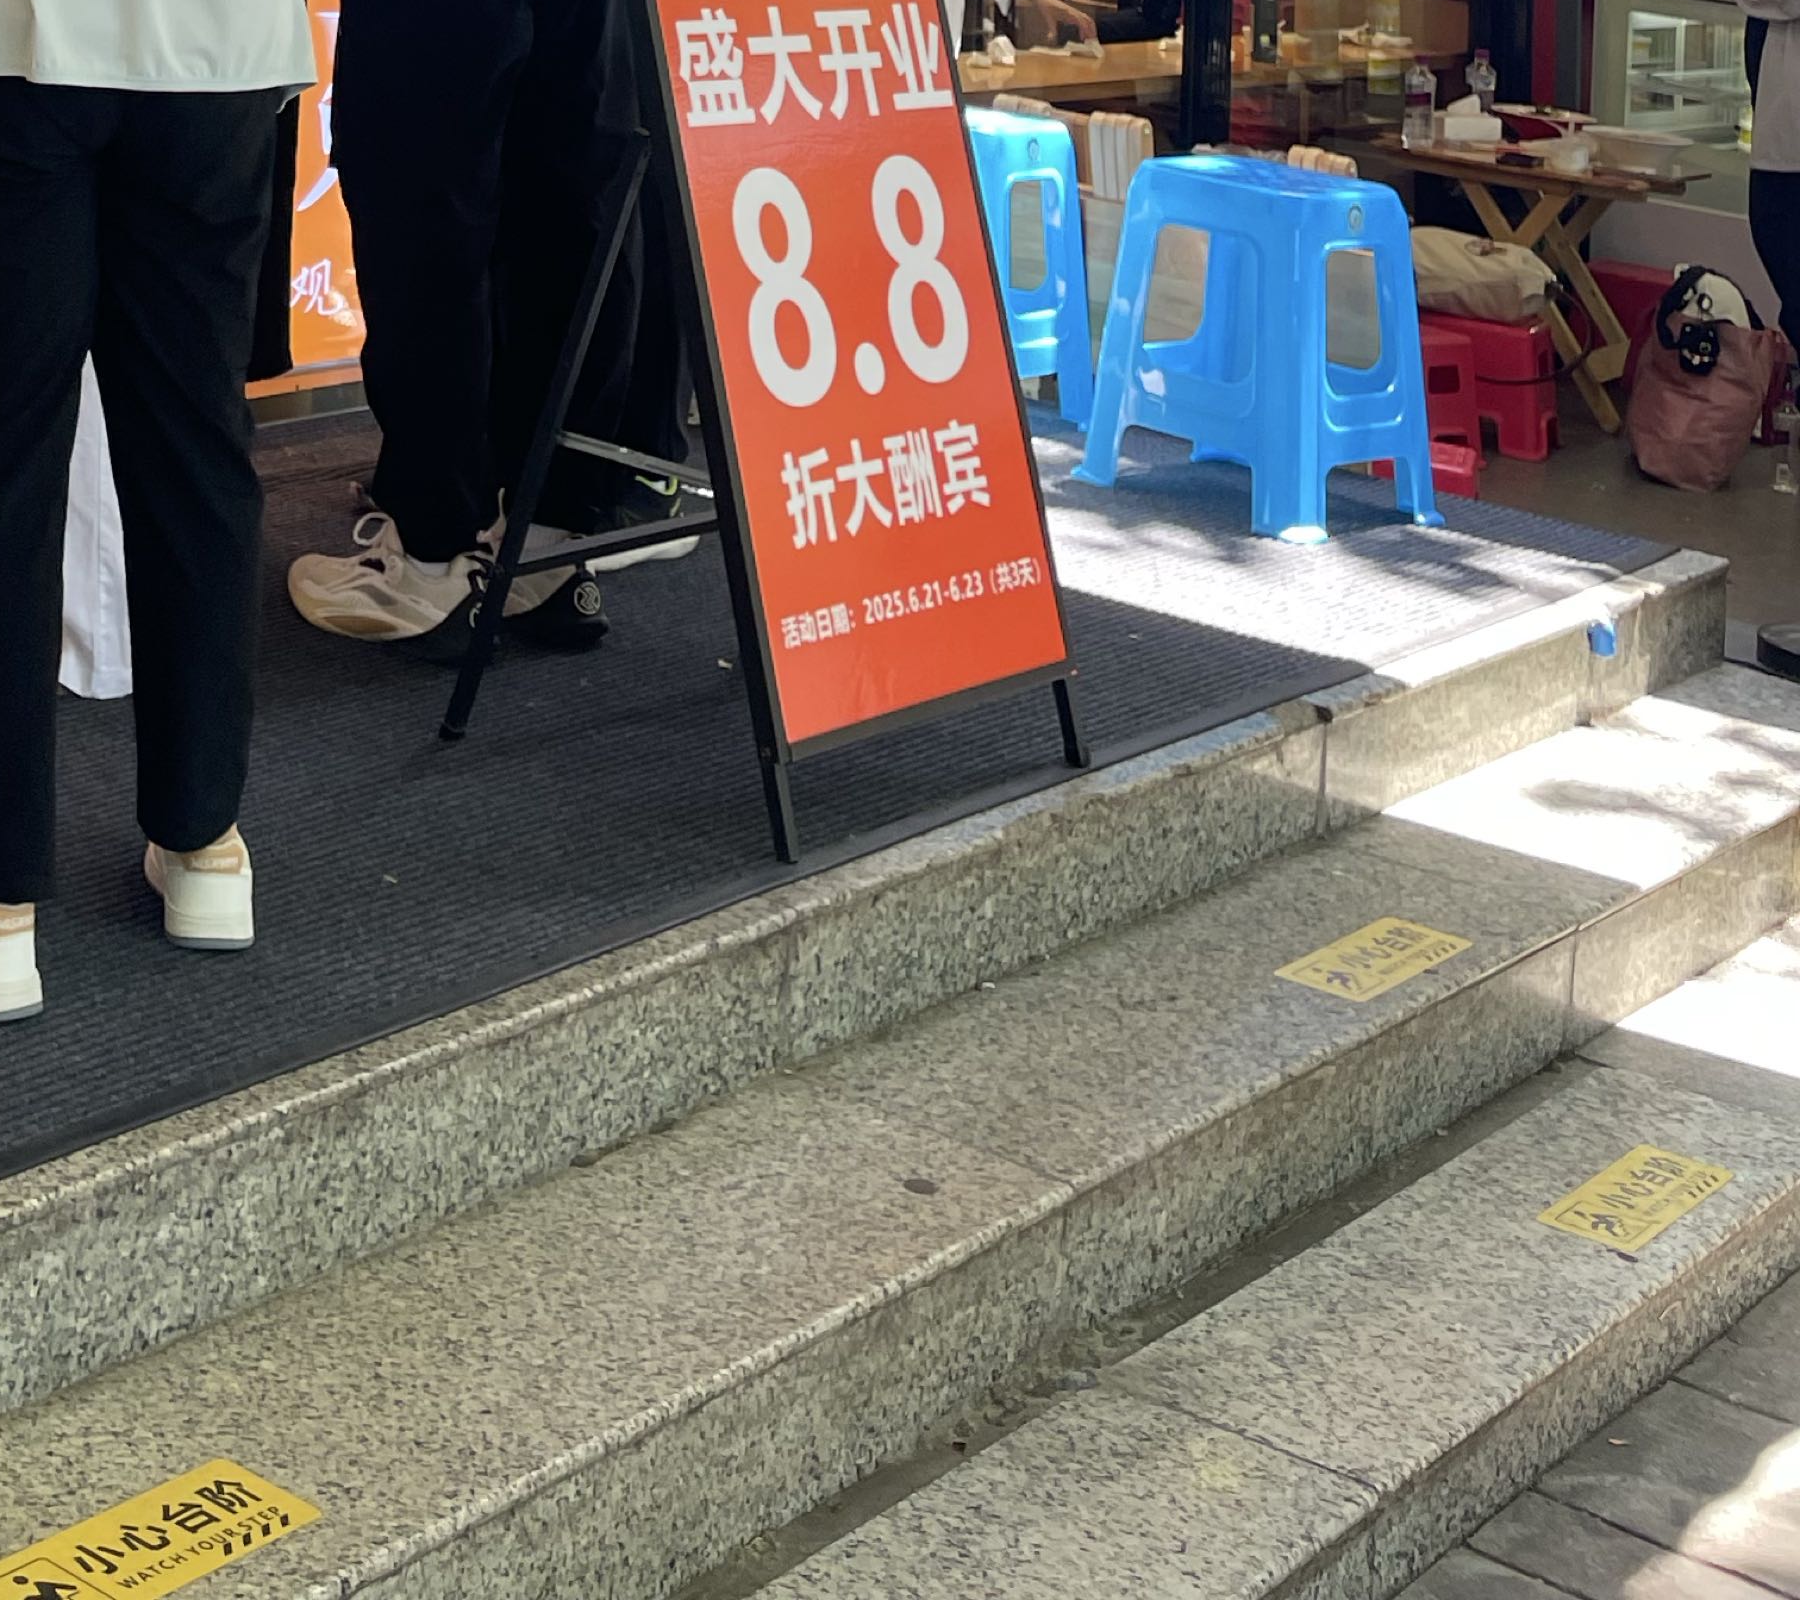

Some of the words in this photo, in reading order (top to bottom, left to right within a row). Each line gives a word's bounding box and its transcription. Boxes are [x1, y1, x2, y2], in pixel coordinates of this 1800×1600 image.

[675, 2, 953, 128] 盛大开业
[731, 154, 970, 408] 8.8
[781, 419, 992, 550] 折大酬宾
[73, 1479, 263, 1576] 小心台阶
[117, 1554, 188, 1590] WATCH
[188, 1527, 241, 1557] YOUR
[240, 1505, 280, 1534] STEP
